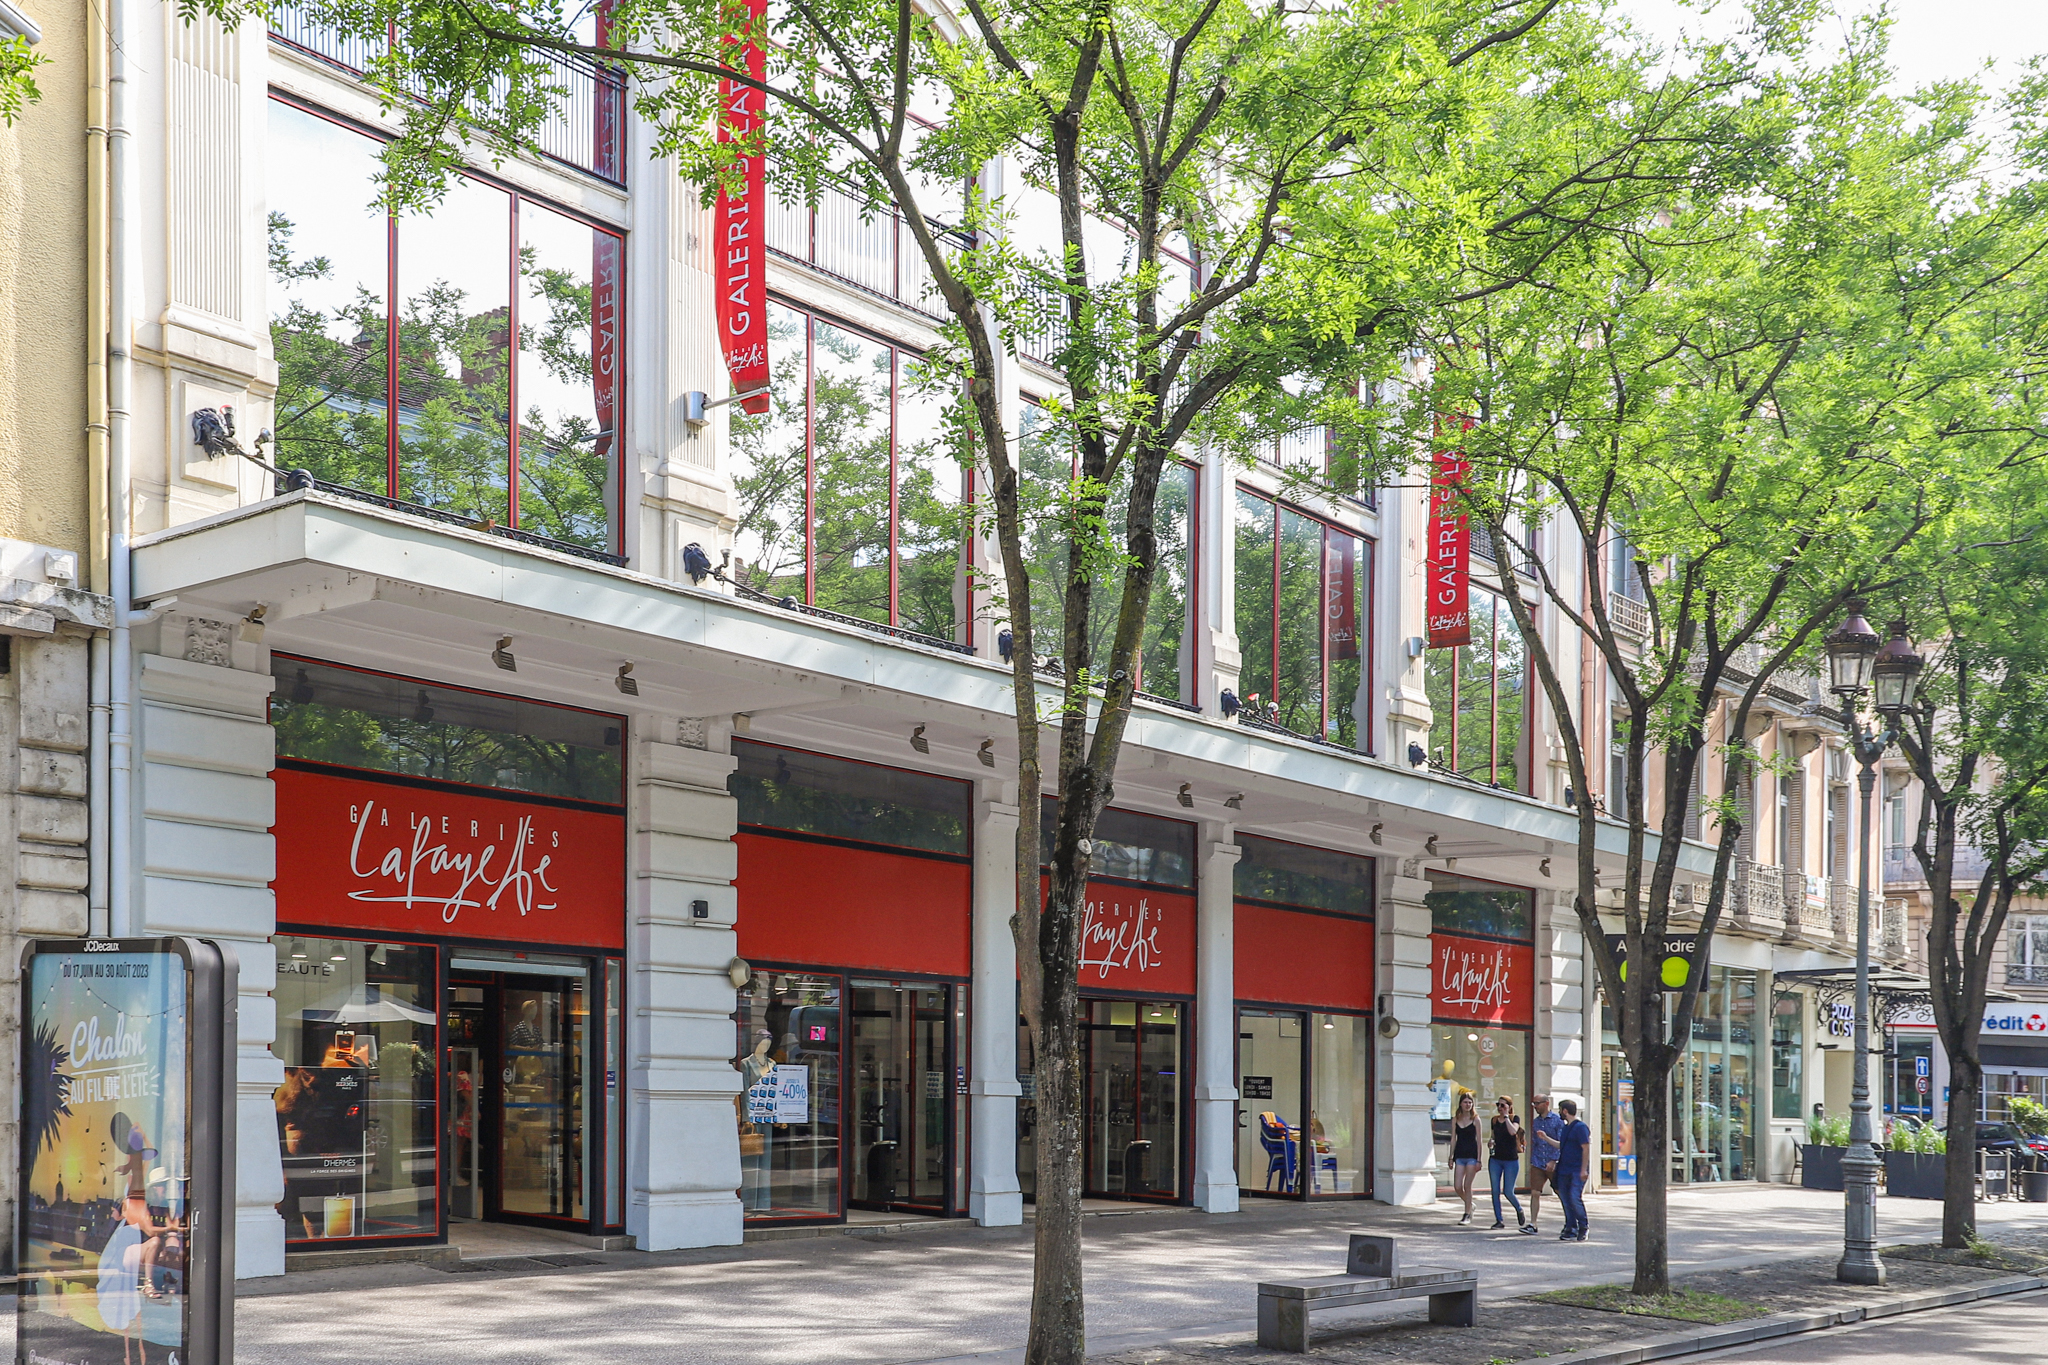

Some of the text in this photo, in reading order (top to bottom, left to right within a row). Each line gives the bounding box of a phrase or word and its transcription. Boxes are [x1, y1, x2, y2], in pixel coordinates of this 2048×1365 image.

[350, 804, 559, 848] GALERIES
[347, 799, 559, 924] Lafayette
[1083, 898, 1162, 921] LERIES
[83, 940, 120, 952] JCDecaux
[1079, 898, 1162, 979] fayette
[1442, 948, 1511, 968] GALERIES
[63, 962, 149, 978] DU 17 JUIN AU 30 AOÛT 2023
[277, 963, 331, 977] EAUTÉ
[1441, 946, 1511, 1014] Lafayette
[1982, 1015, 2024, 1031] édit
[70, 1011, 147, 1069] Chalon
[70, 1067, 149, 1105] AU FIL DE L'ÉTÉ
[779, 1084, 807, 1099] -40%
